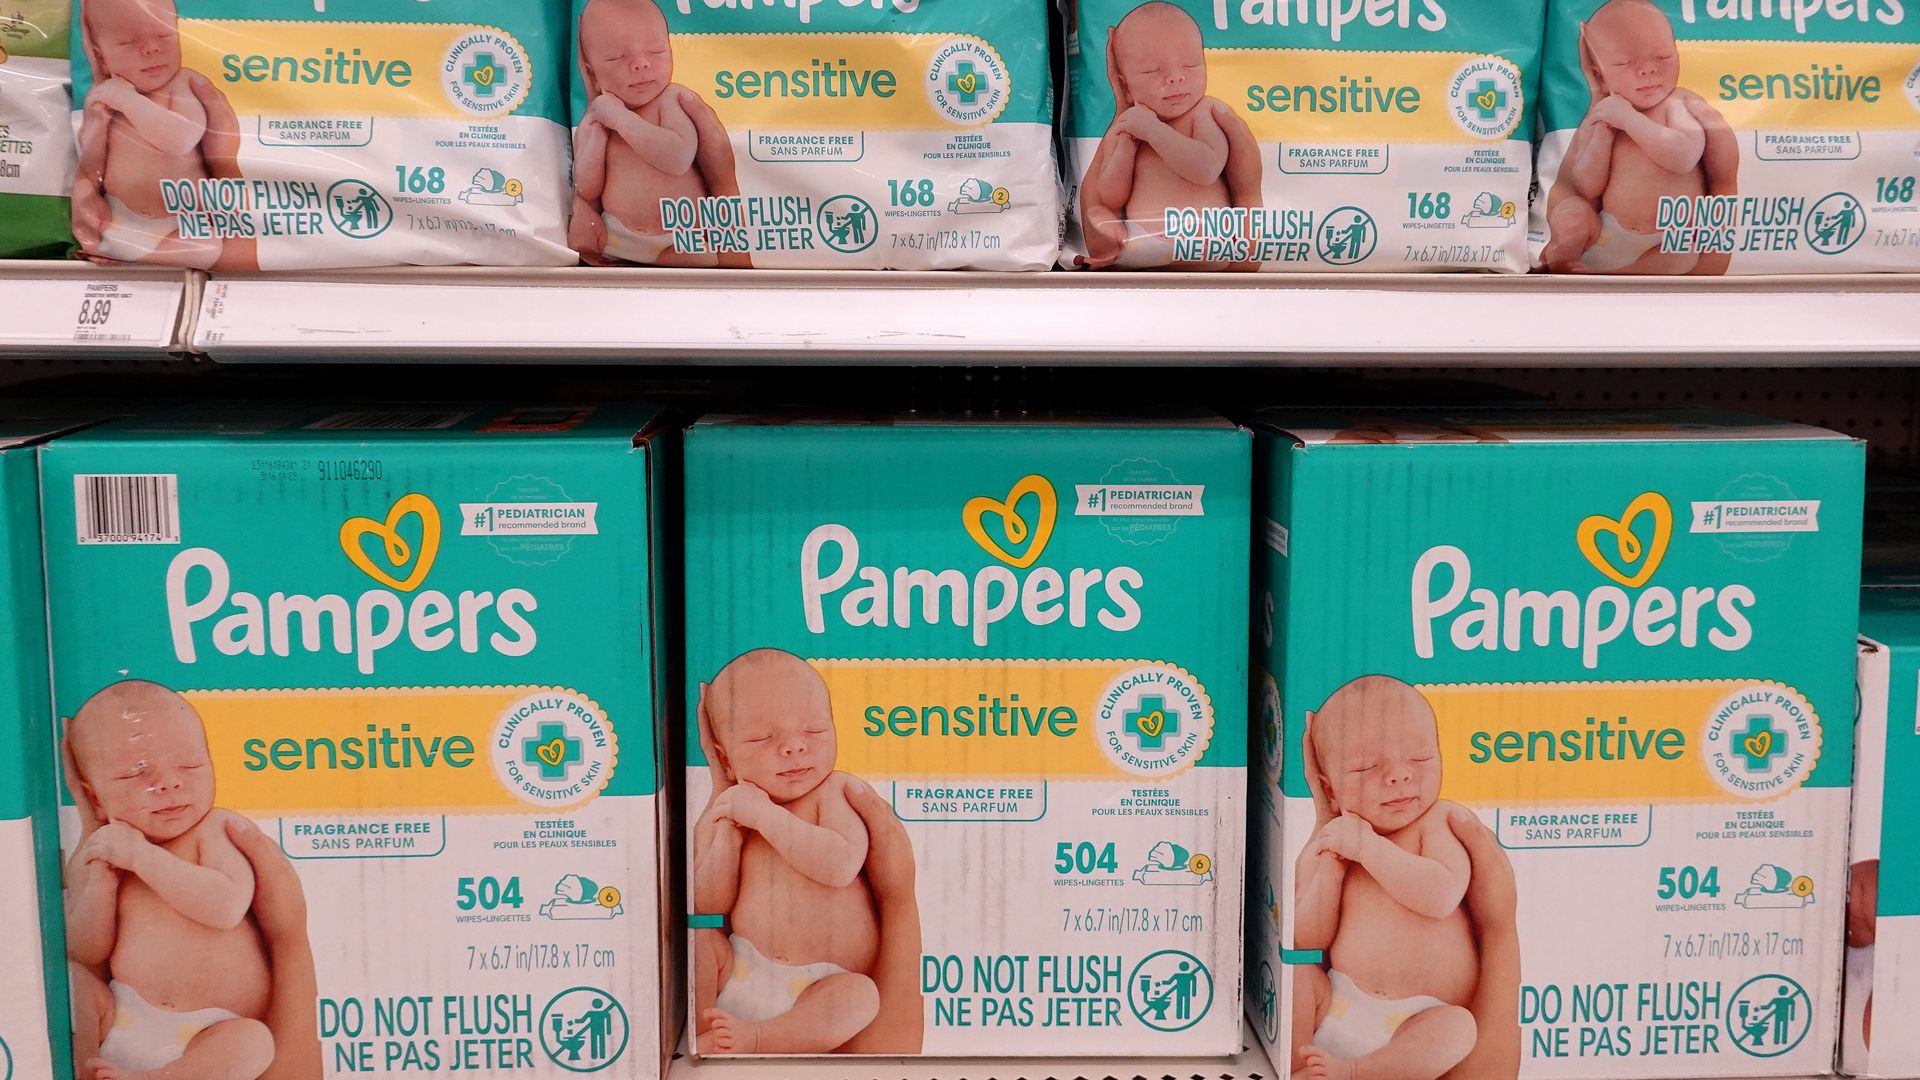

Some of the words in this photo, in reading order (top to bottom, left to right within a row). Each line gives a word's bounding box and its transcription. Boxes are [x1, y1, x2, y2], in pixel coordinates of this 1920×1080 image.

[223, 49, 413, 88] sensitive
[715, 58, 896, 99] sensitive
[1246, 75, 1421, 114] sensitive
[1718, 63, 1880, 103] sensitive
[268, 120, 333, 130] FRAGRANCE
[336, 120, 362, 130] FREE
[279, 131, 308, 141] SANS
[310, 131, 351, 141] PARFUM
[759, 136, 824, 146] FRAGRANCE
[827, 136, 854, 146] FREE
[770, 147, 798, 157] SANS
[801, 147, 843, 157] PARFUM
[1288, 149, 1351, 158] FRAGRANCE
[1354, 149, 1380, 158] FREE
[1765, 135, 1825, 145] FRAGRANCE
[1828, 135, 1852, 144] FREE
[1775, 145, 1803, 155] SANS
[1805, 144, 1843, 154] PARFUM
[1299, 159, 1325, 169] SANS
[1329, 159, 1369, 169] PARFUM
[395, 164, 445, 194] 168
[1875, 176, 1916, 204] 168
[163, 179, 197, 212] DO
[202, 179, 246, 213] NOT
[253, 180, 322, 211] FLUSH
[887, 179, 935, 208] 168
[1408, 192, 1452, 219] 168
[180, 212, 211, 238] NE
[217, 212, 256, 238] PAS
[262, 212, 324, 236] JETER
[662, 199, 694, 230] DO
[699, 198, 742, 230] NOT
[749, 196, 812, 227] FLUSH
[1166, 209, 1200, 238] DO
[1203, 209, 1247, 238] NOT
[1251, 210, 1314, 240] FLUSH
[1658, 197, 1690, 228] DO
[1693, 197, 1737, 227] NOT
[1741, 196, 1806, 226] FLUSH
[674, 230, 704, 254] NE
[709, 229, 751, 254] PAS
[754, 228, 815, 252] JETER
[1174, 239, 1202, 262] NE
[1209, 240, 1250, 263] PAS
[1252, 241, 1312, 263] JETER
[1661, 229, 1692, 252] NE
[1695, 229, 1737, 252] PAS
[1739, 228, 1799, 251] JETER
[78, 299, 112, 325] 8.89
[1087, 487, 1107, 512] #1
[1111, 490, 1193, 500] PEDIATRICIAN
[1111, 502, 1168, 510] recommended
[1169, 502, 1193, 510] brand
[473, 506, 494, 532] #1
[497, 508, 585, 519] PEDIATRICIAN
[498, 521, 559, 529] recommended
[561, 520, 586, 529] brand
[1702, 504, 1723, 529] #1
[1726, 506, 1808, 516] PEDIATRICIAN
[801, 524, 1143, 646] Pampers
[166, 548, 538, 674] Pampers
[1412, 545, 1755, 668] Pampers
[1101, 673, 1164, 720] CLINICALLY
[1166, 676, 1203, 720] PROVEN
[499, 699, 564, 748] CLINICALLY
[566, 702, 607, 748] PROVEN
[864, 694, 1078, 738] sensitive
[1708, 692, 1773, 742] CLINICALLY
[1774, 695, 1811, 741] PROVEN
[244, 724, 475, 771] sensitive
[1106, 731, 1123, 754] FOR
[1121, 752, 1179, 769] SENSITIVE
[1177, 732, 1198, 757] SKIN
[1470, 717, 1686, 763] sensitive
[505, 760, 524, 784] FOR
[522, 782, 582, 800] SENSITIVE
[581, 760, 602, 786] SKIN
[1713, 752, 1730, 776] FOR
[1727, 773, 1784, 791] SENSITIVE
[1782, 752, 1805, 778] SKIN
[906, 788, 995, 800] FRAGRANCE
[999, 788, 1034, 800] FREE
[1120, 798, 1134, 807] EN
[1135, 798, 1181, 807] CLINIQUE
[1131, 787, 1170, 797] TESTÉES
[921, 802, 958, 813] SANS
[962, 802, 1019, 813] PARFUM
[1091, 809, 1116, 817] POUR
[1117, 809, 1133, 817] LES
[1135, 809, 1163, 817] PEAUX
[1164, 809, 1209, 817] SENSIBLES
[1510, 814, 1599, 826] FRAGRANCE
[1604, 813, 1638, 825] FREE
[1735, 810, 1775, 820] TESTÉES
[294, 823, 390, 836] FRAGRANCE
[394, 822, 432, 834] FREE
[523, 830, 537, 839] EN
[538, 829, 586, 839] CLINIQUE
[534, 819, 575, 829] TESTÉES
[1525, 828, 1561, 840] SANS
[1565, 827, 1622, 839] PARFUM
[1724, 821, 1738, 830] EN
[1739, 820, 1785, 830] CLINIQUE
[311, 837, 350, 849] SANS
[355, 837, 415, 849] PARFUM
[493, 841, 519, 849] POUR
[520, 841, 537, 849] LES
[538, 841, 568, 849] PEAUX
[569, 839, 617, 848] SENSIBLES
[1054, 841, 1119, 874] 504
[455, 876, 524, 911] 504
[1656, 865, 1721, 900] 504
[1063, 909, 1071, 931] 7
[1073, 916, 1082, 931] x
[1084, 909, 1105, 932] 6.7
[1108, 908, 1149, 935] in/17.8
[1152, 916, 1160, 931] x
[1164, 909, 1178, 931] 17
[1181, 915, 1203, 931] cm
[922, 955, 964, 994] DO
[973, 954, 1029, 993] NOT
[1038, 954, 1122, 993] FLUSH
[319, 997, 365, 1038] DO
[374, 996, 433, 1037] NOT
[443, 994, 532, 1036] FLUSH
[935, 997, 971, 1026] NE
[981, 997, 1034, 1027] PAS
[1041, 997, 1123, 1026] JETER
[1521, 984, 1563, 1025] DO
[1571, 983, 1628, 1024] NOT
[1636, 980, 1721, 1022] FLUSH
[1532, 1026, 1570, 1058] NE
[1579, 1025, 1632, 1057] PAS
[1639, 1024, 1720, 1056] JETER
[335, 1041, 374, 1072] NE
[386, 1039, 441, 1072] PAS
[448, 1038, 535, 1071] JETER
